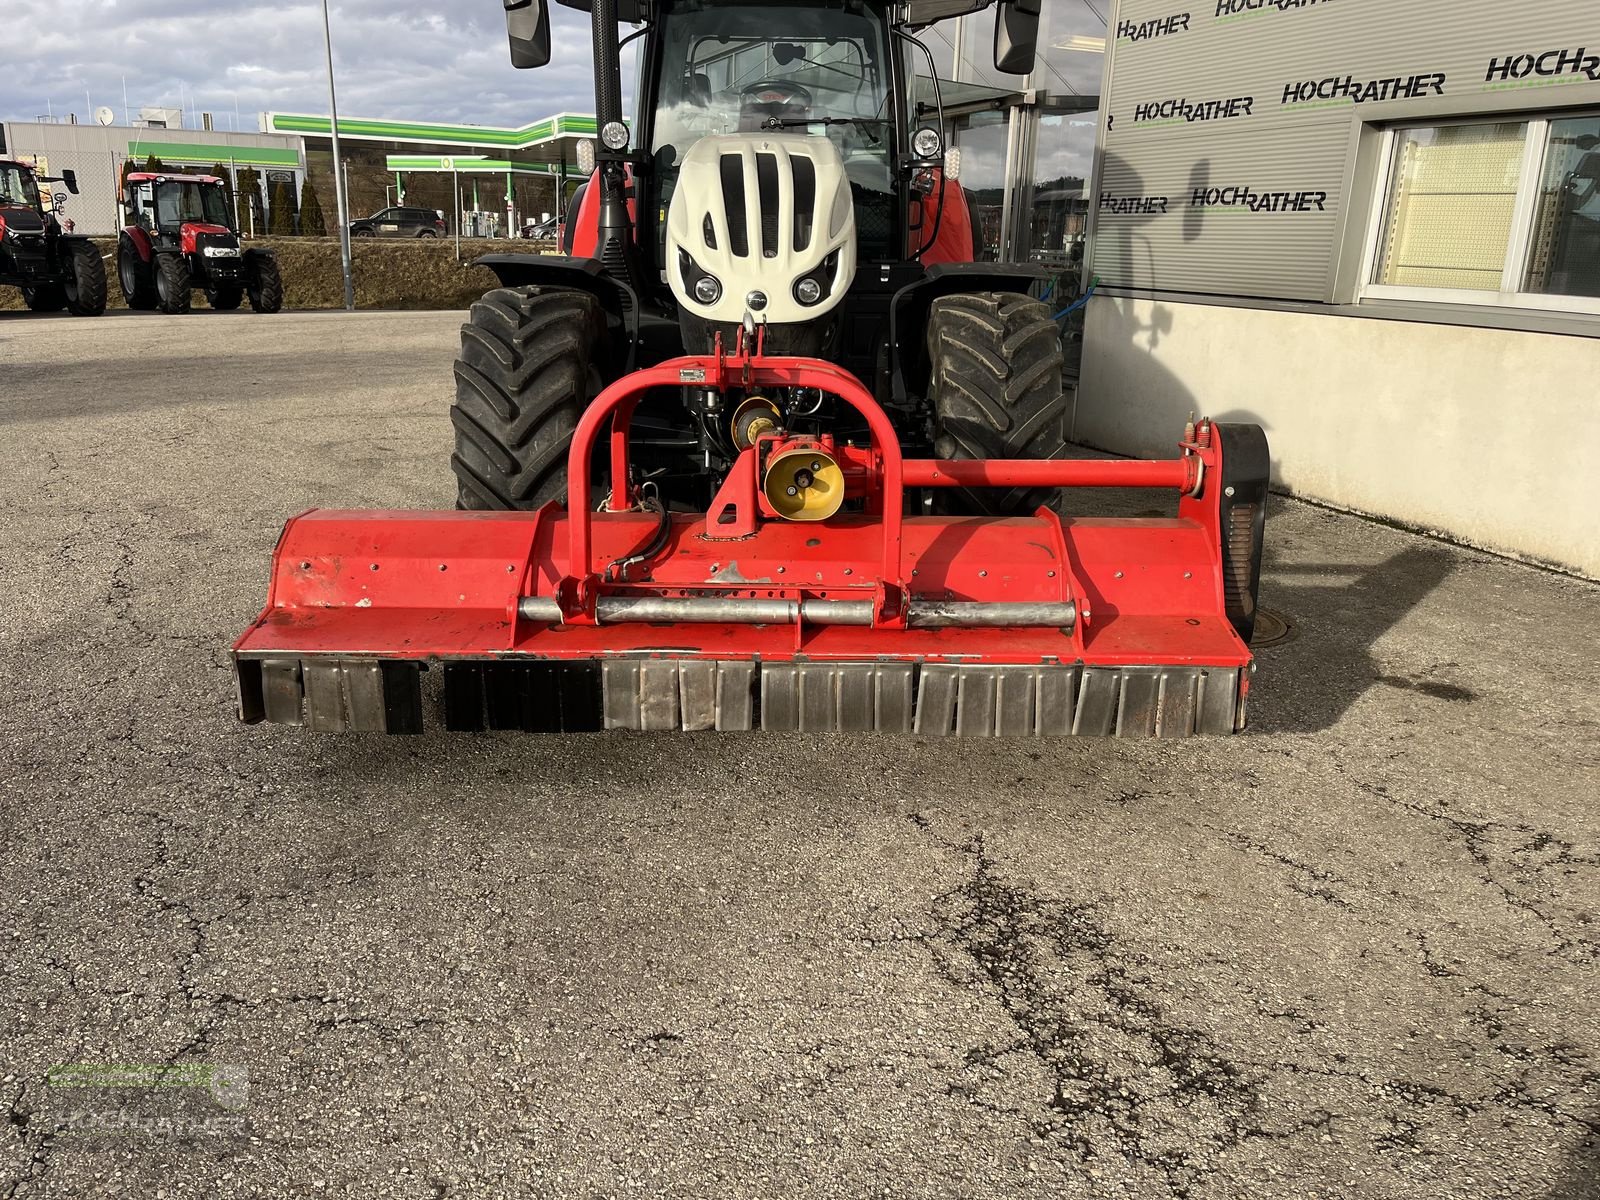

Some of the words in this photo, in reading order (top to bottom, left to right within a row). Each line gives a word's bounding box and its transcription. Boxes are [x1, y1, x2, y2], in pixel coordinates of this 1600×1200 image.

[1485, 47, 1600, 81] HOCHR
[1281, 73, 1446, 103] HOCHRATHER
[1134, 97, 1253, 122] HOCHRATHER
[1192, 186, 1327, 212] HOCHRATHER
